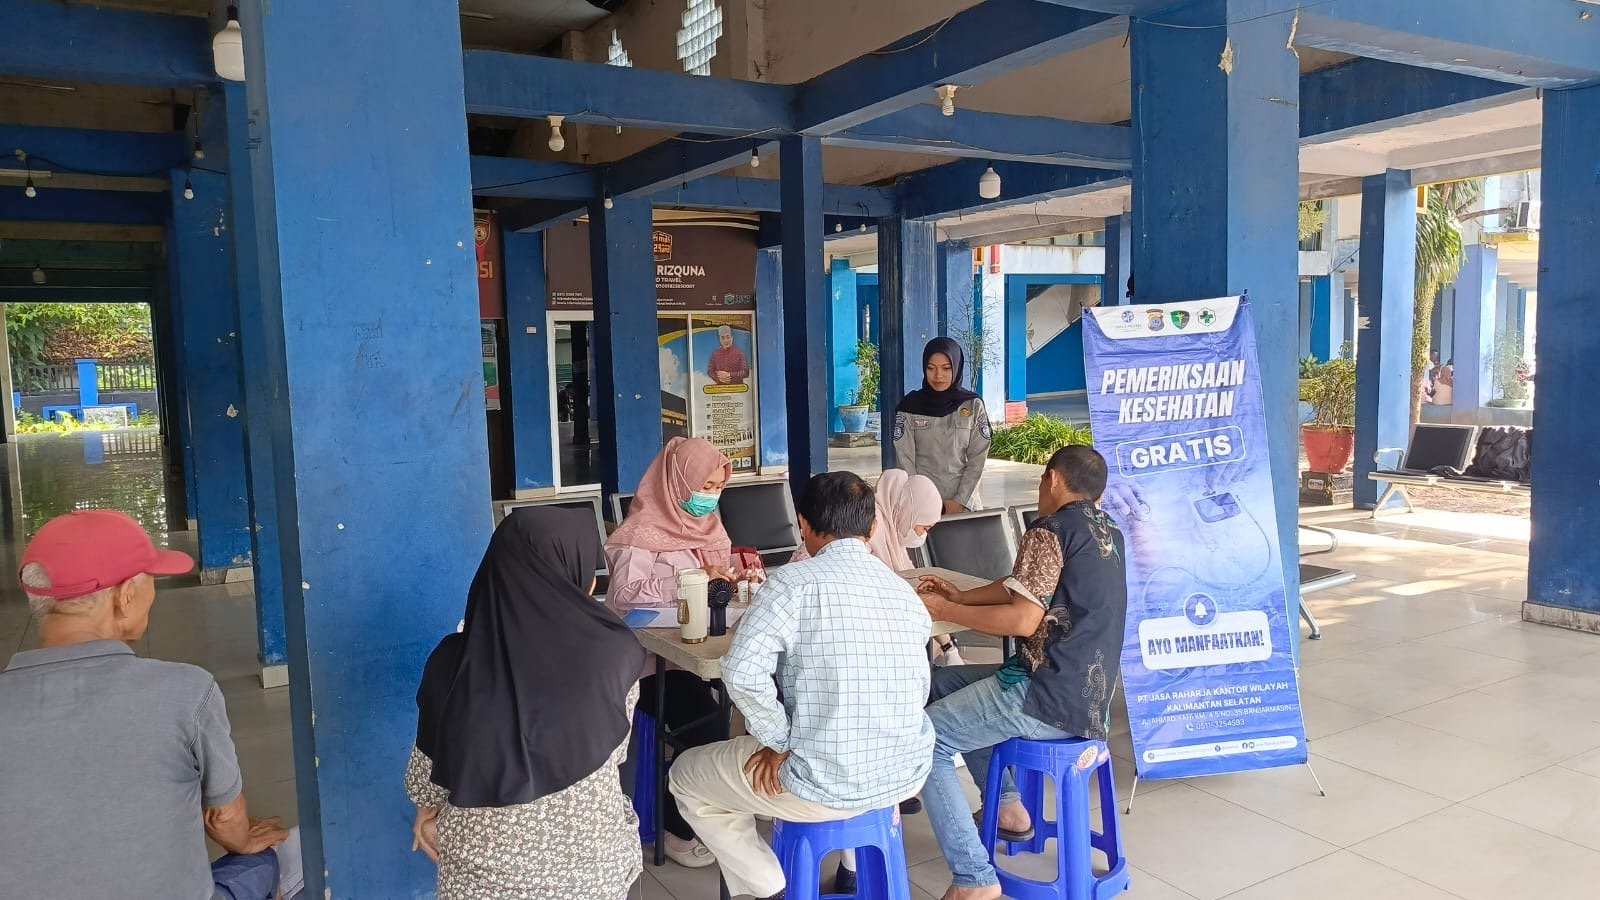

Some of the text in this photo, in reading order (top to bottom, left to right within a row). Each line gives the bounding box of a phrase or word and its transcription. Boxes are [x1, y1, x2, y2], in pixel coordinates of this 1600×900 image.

[656, 265, 705, 277] RIZQUNA
[1101, 360, 1246, 396] PEMERIKSAAN
[1117, 390, 1235, 424] KESEHATAN
[1130, 434, 1233, 469] GRATIS
[1147, 629, 1265, 656] AYO MANFAATKAN!
[1137, 681, 1289, 704] PT JASA RAHARJA KANTOR WILAYAH
[1166, 696, 1262, 712] KALIMANTAN SELATAN
[1152, 715, 1176, 724] AHMAD
